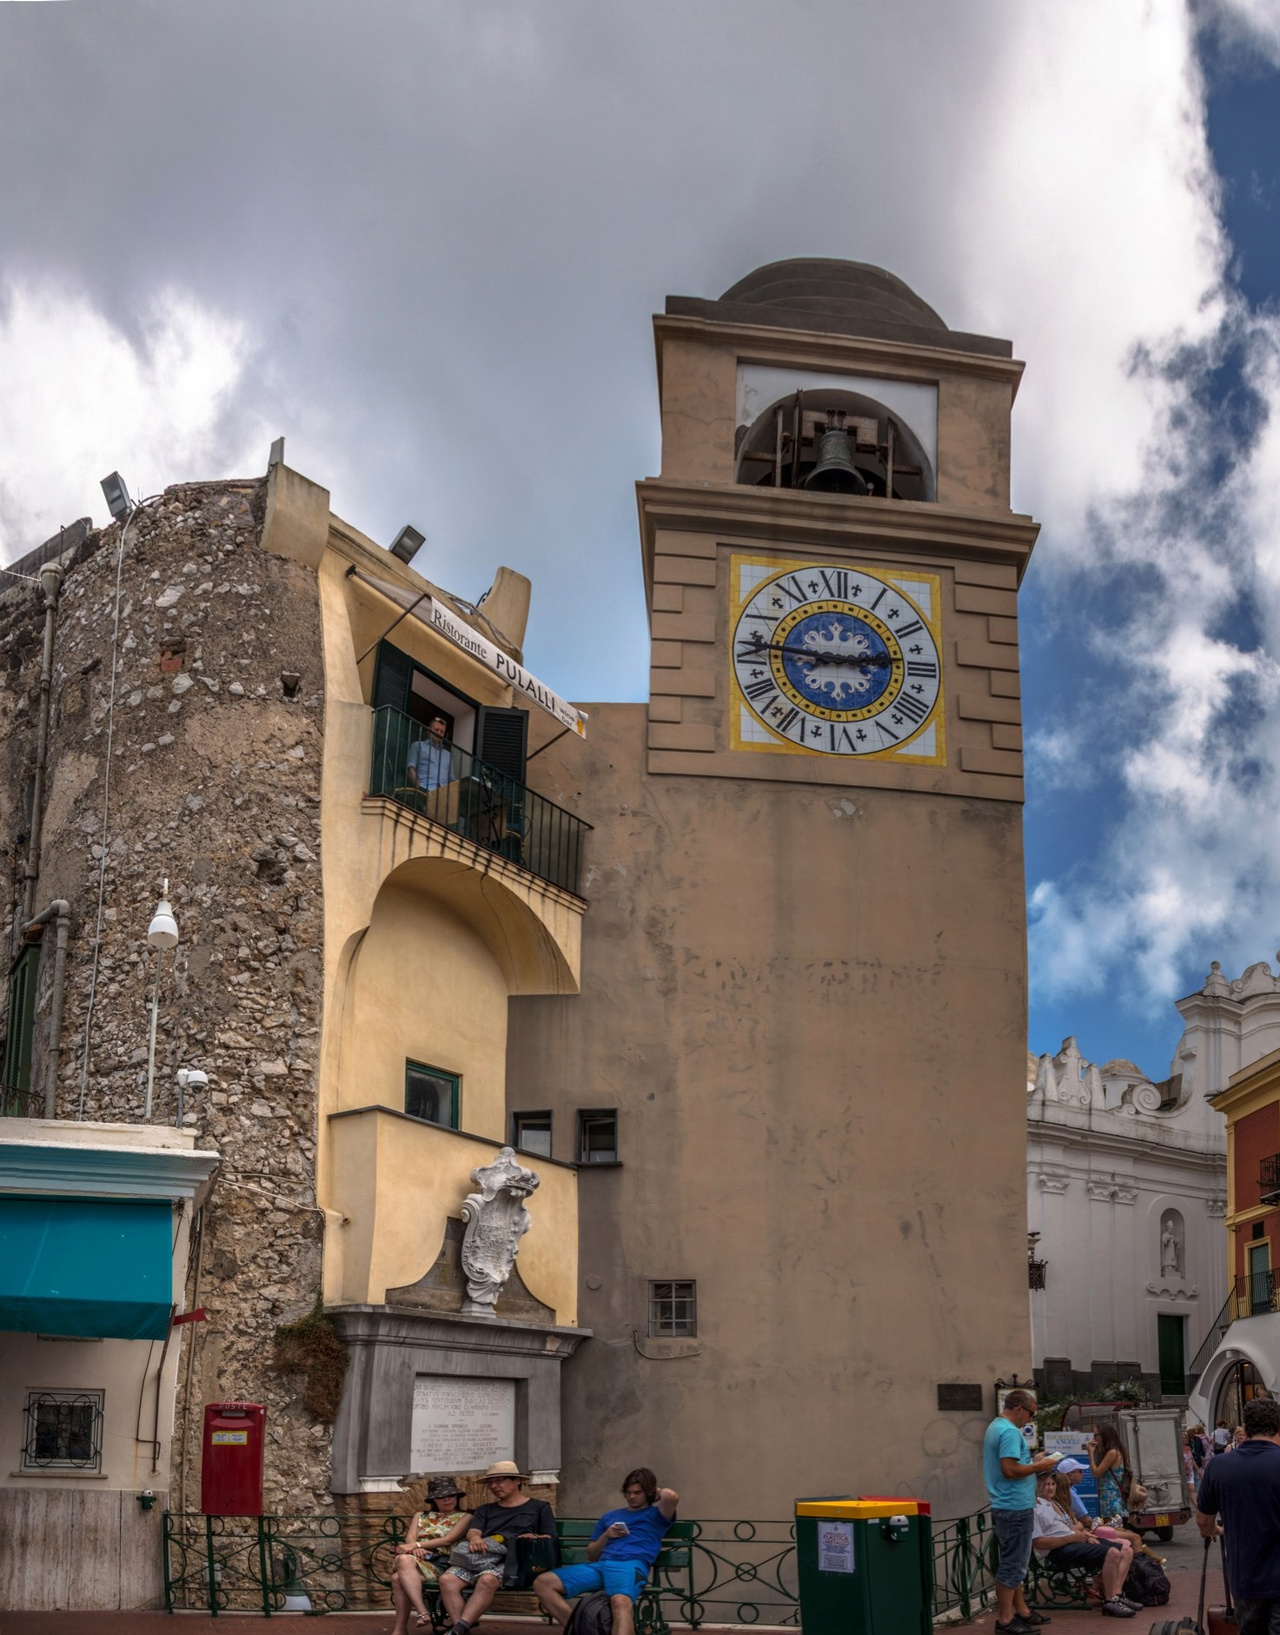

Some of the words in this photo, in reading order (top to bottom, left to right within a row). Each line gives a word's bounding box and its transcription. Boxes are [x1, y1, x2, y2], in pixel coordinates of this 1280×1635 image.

[818, 569, 849, 600] XII
[893, 619, 924, 640] II
[432, 608, 488, 659] Ristorante
[495, 652, 556, 713] PULALLI
[906, 660, 937, 679] III
[559, 706, 576, 724] wine
[561, 714, 574, 727] bar
